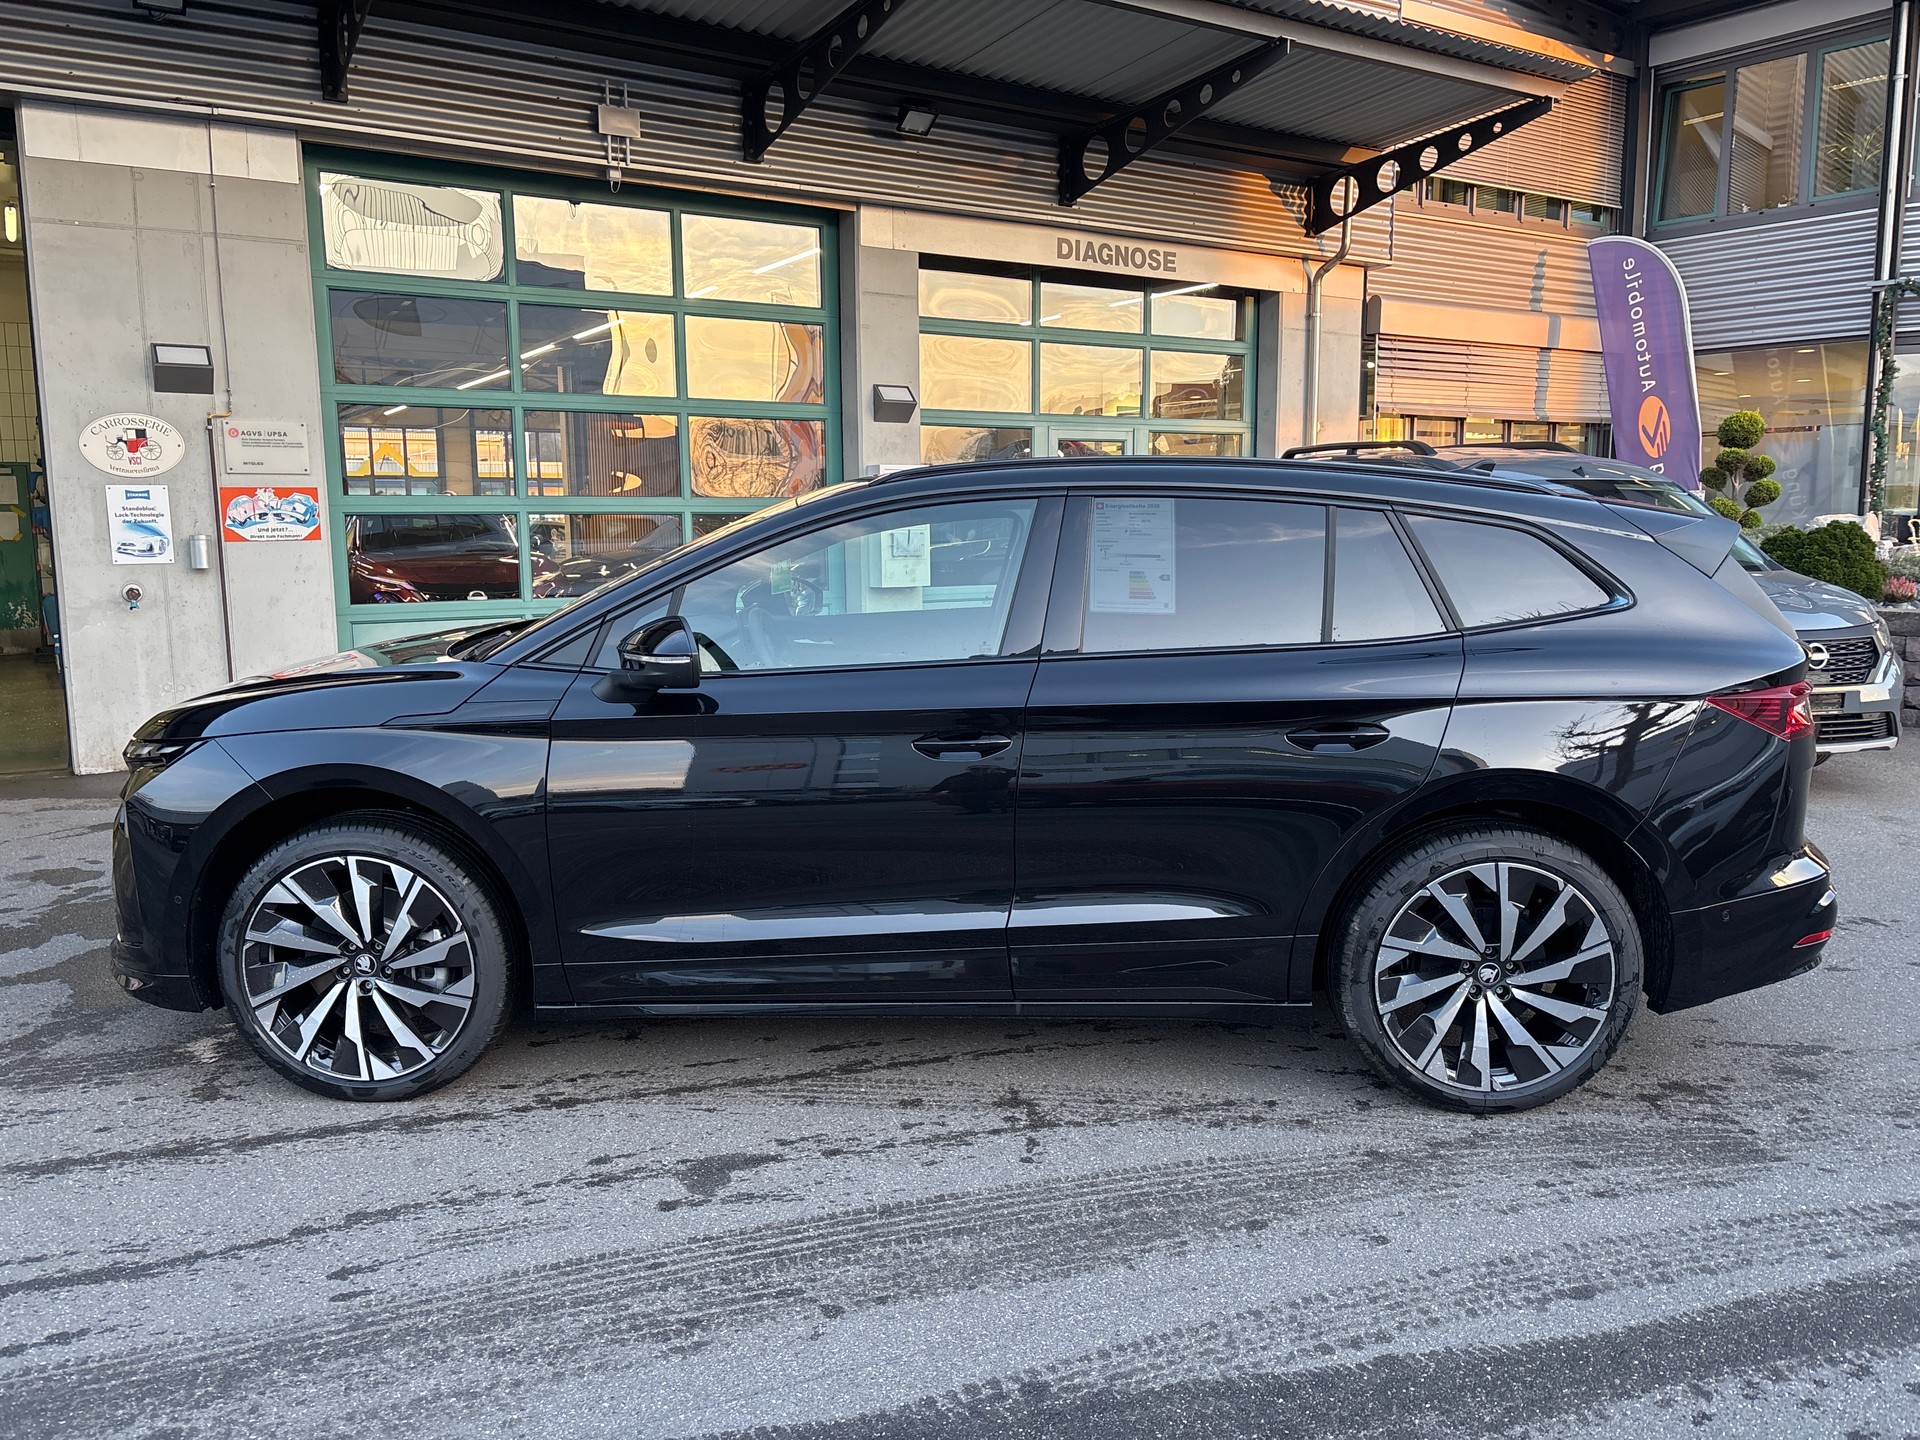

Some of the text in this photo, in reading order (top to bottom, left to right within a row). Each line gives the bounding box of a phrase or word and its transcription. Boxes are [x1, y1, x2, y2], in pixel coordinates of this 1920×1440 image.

[1056, 237, 1177, 272] DIAGNOSE
[90, 416, 172, 437] CARROSSERIE
[127, 456, 142, 466] VSCI
